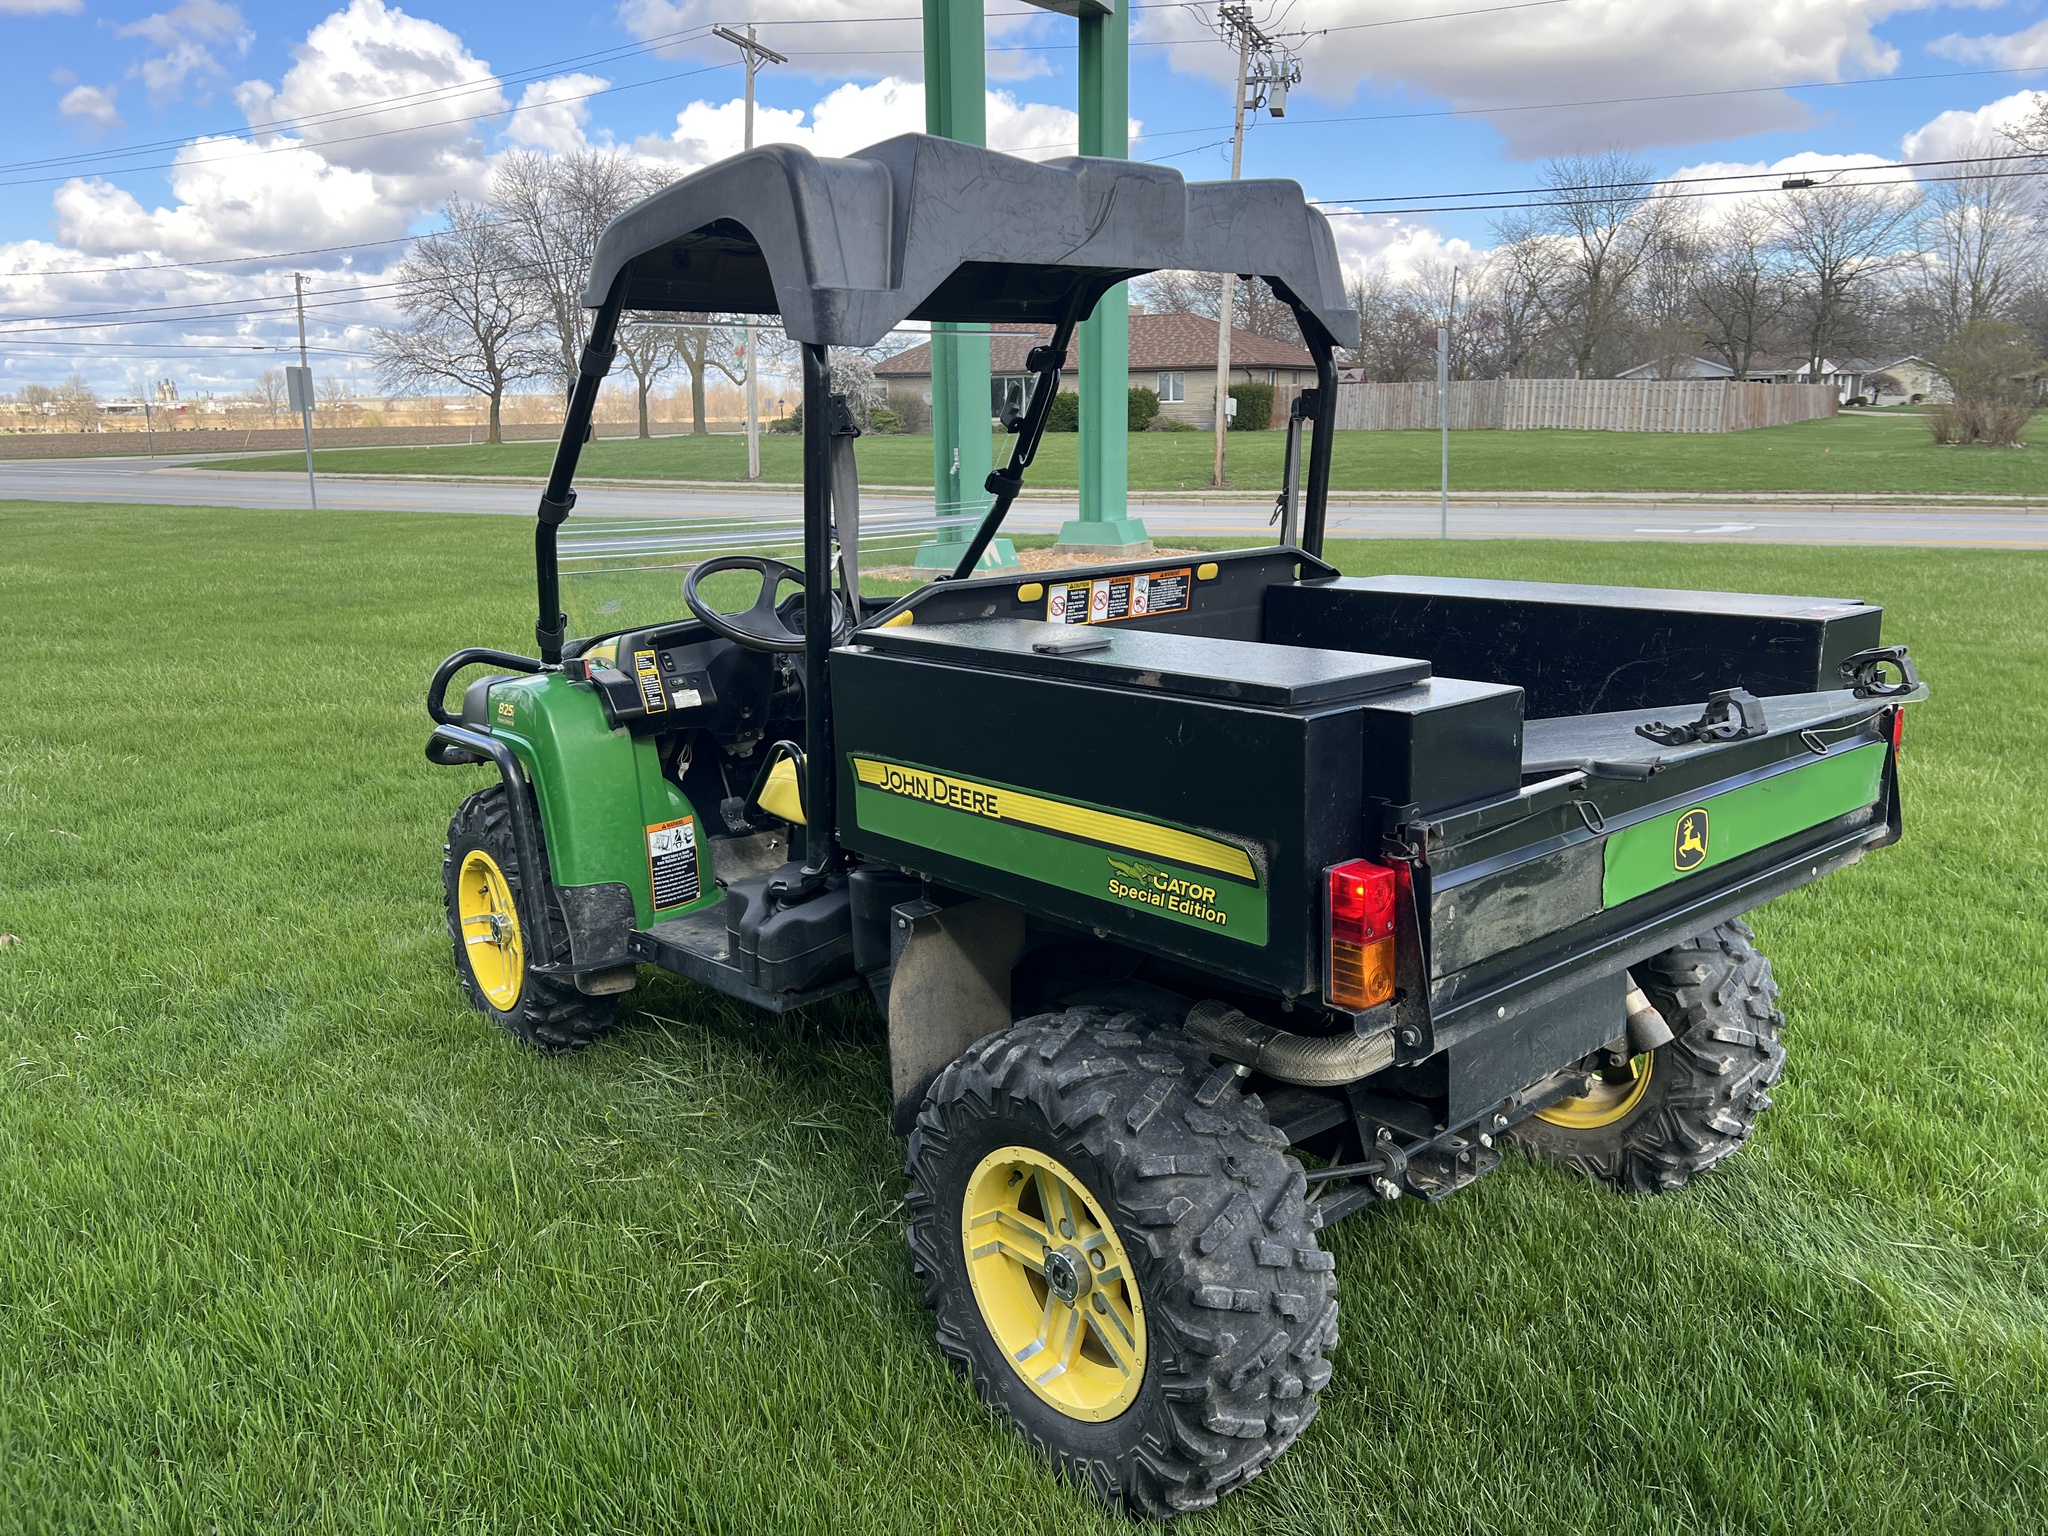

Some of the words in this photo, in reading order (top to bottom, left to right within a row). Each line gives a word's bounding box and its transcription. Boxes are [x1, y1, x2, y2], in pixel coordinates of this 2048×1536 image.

[880, 766, 930, 798] JOHN
[933, 777, 1000, 815] DEERE
[1108, 879, 1166, 907] Special
[1167, 895, 1228, 925] Edition
[1153, 872, 1217, 904] GATOR
